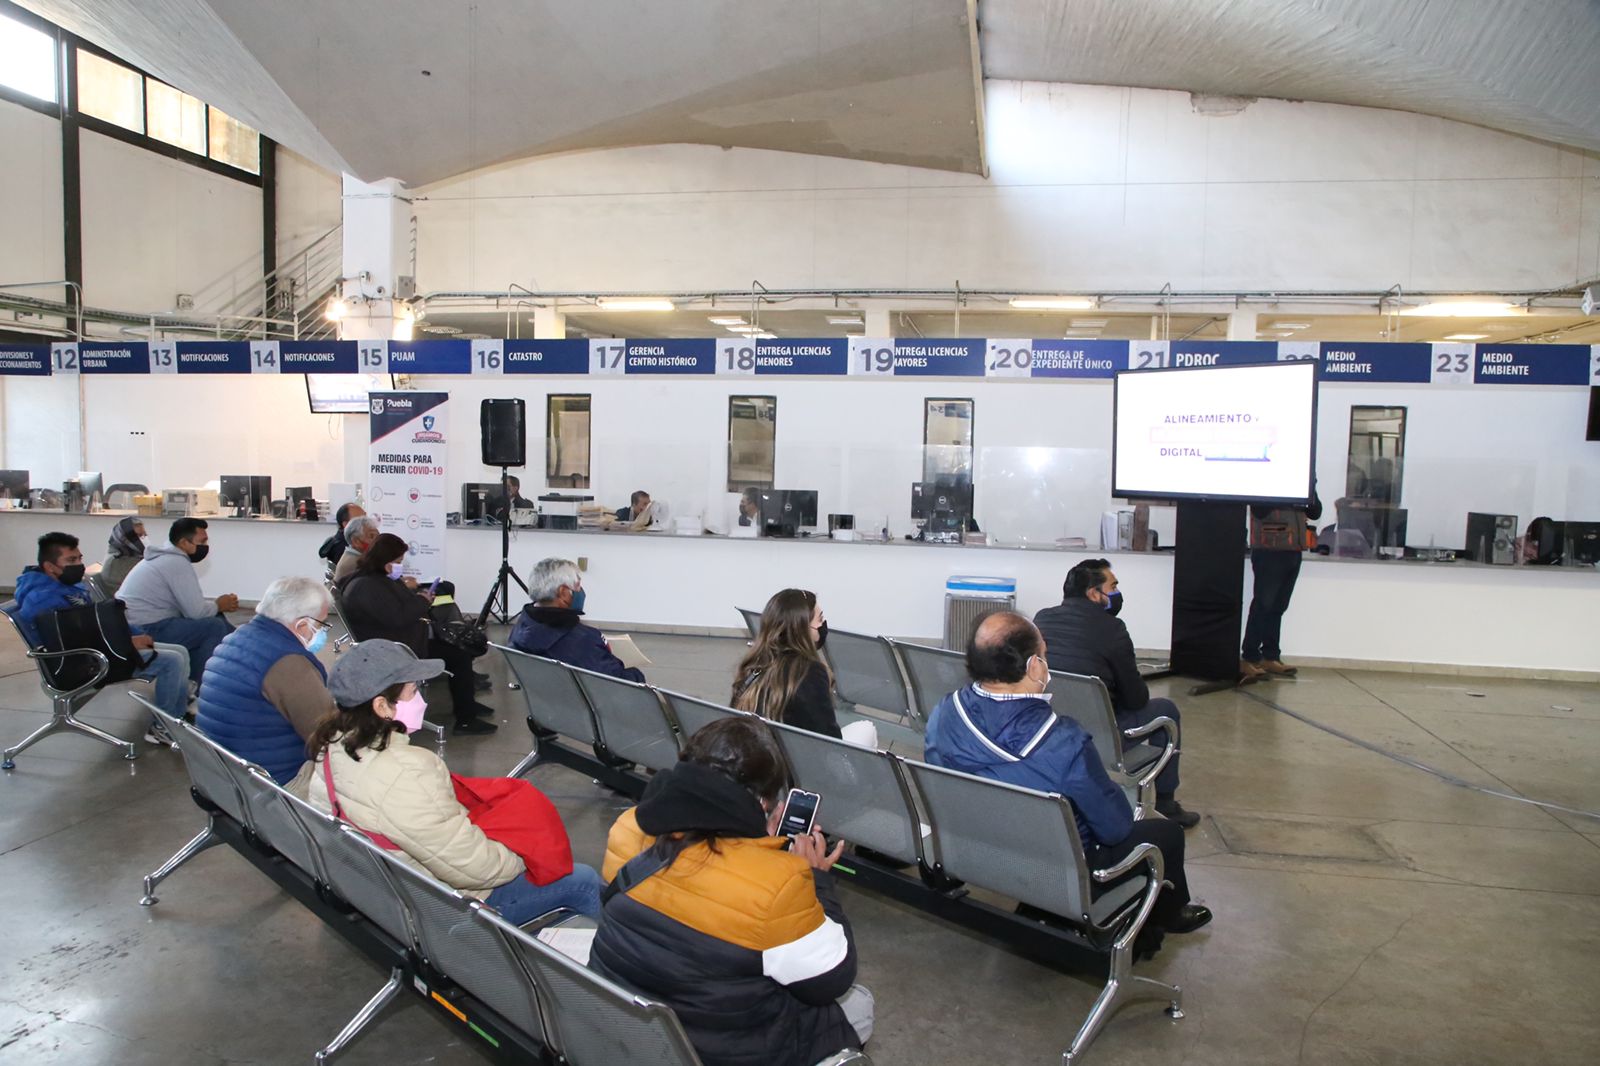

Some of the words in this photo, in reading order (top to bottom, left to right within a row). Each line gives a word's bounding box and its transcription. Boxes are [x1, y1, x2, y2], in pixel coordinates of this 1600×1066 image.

[82, 349, 131, 359] ADMINISTRACIÓN
[391, 352, 415, 361] PUAM
[508, 352, 543, 361] CATASTRO
[629, 347, 665, 356] GERENCIA
[757, 346, 791, 356] ENTREGA
[792, 346, 831, 356] LICENCIAS
[894, 346, 926, 356] NTREGA
[928, 346, 968, 356] LICENCIAS
[1031, 350, 1070, 360] ENTREGA
[1073, 351, 1085, 360] DE
[1326, 351, 1355, 361] MEDIO
[53, 348, 77, 369] 12
[152, 349, 172, 366] 13
[181, 354, 229, 362] NOTIFICACIONES
[254, 349, 276, 367] 14
[284, 353, 335, 362] NOTIFICACIONES
[360, 348, 382, 366] 15
[478, 350, 500, 368] 16
[596, 346, 625, 369] 17
[629, 357, 657, 366] CENTRO
[658, 355, 697, 366] HISTÓRICO
[724, 347, 754, 370] 18
[757, 357, 793, 366] MENORES
[861, 348, 894, 371] 19
[996, 348, 1031, 368] 20
[1138, 350, 1164, 369] 21
[1482, 353, 1513, 363] MEDIO
[83, 359, 107, 368] URBANA
[1031, 359, 1083, 369] EXPEDIENTE
[1085, 357, 1112, 369] ÚNICO
[1325, 363, 1372, 373] AMBIENTE
[1436, 353, 1469, 373] 23
[1481, 365, 1529, 376] AMBIENTE
[387, 399, 412, 408] Puebla
[1164, 413, 1252, 424] ALINEAMIENTO
[1160, 448, 1203, 457] DIGITAL
[378, 453, 411, 463] MEDIDAS
[413, 455, 433, 464] PARA
[370, 464, 406, 474] PREVENIR
[408, 465, 444, 475] COVID-19
